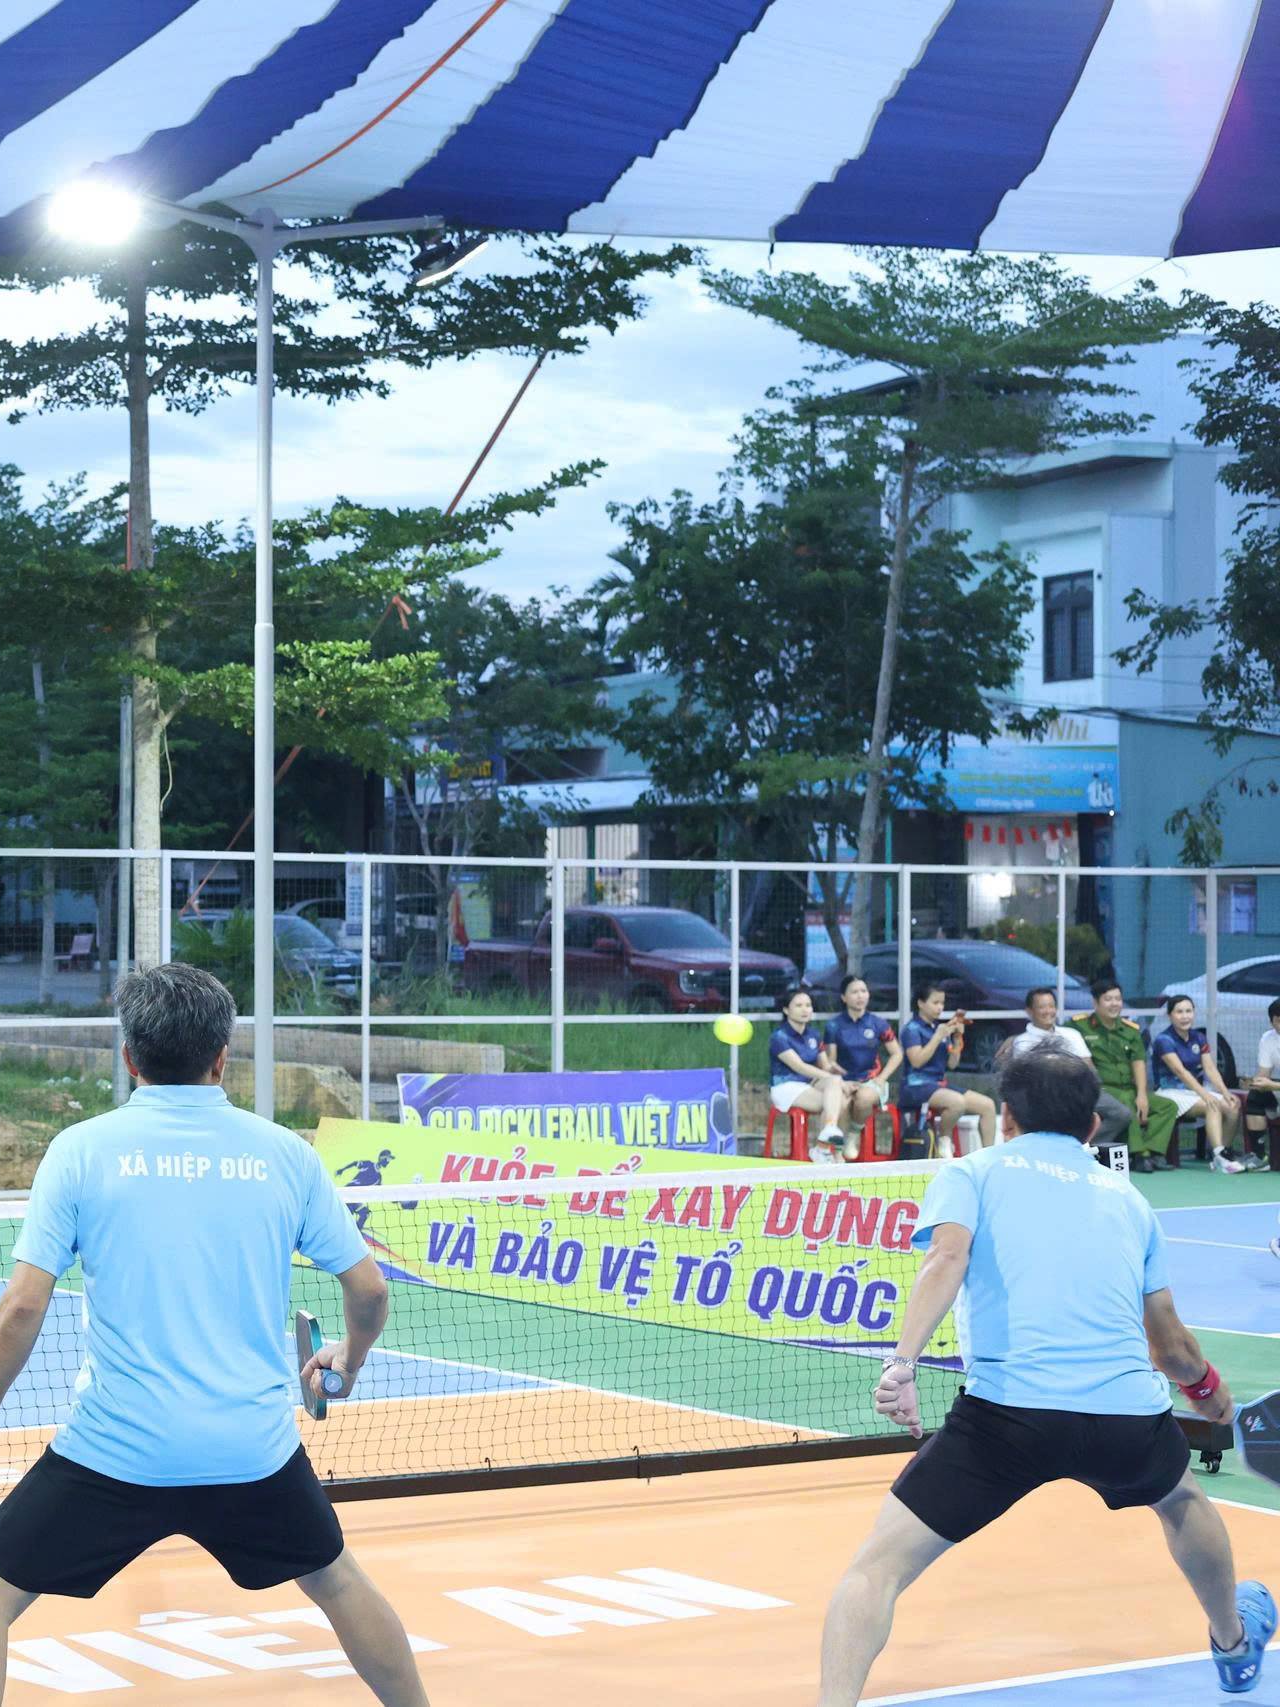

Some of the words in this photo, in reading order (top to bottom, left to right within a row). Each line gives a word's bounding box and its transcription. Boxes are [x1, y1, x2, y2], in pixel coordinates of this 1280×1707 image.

[620, 1097, 671, 1147] VIỆT
[674, 1103, 709, 1144] AN
[118, 1149, 150, 1177] XÃ
[156, 1151, 212, 1184] HIỆP
[219, 1153, 269, 1182] ĐỨC
[763, 1187, 920, 1255] DỰNG
[426, 1217, 477, 1269] VÀ
[490, 1221, 584, 1286] BẢO
[599, 1241, 658, 1307] VỆ
[672, 1241, 743, 1307] TỔ
[747, 1259, 899, 1332] QUỐC
[440, 1567, 797, 1637] AN
